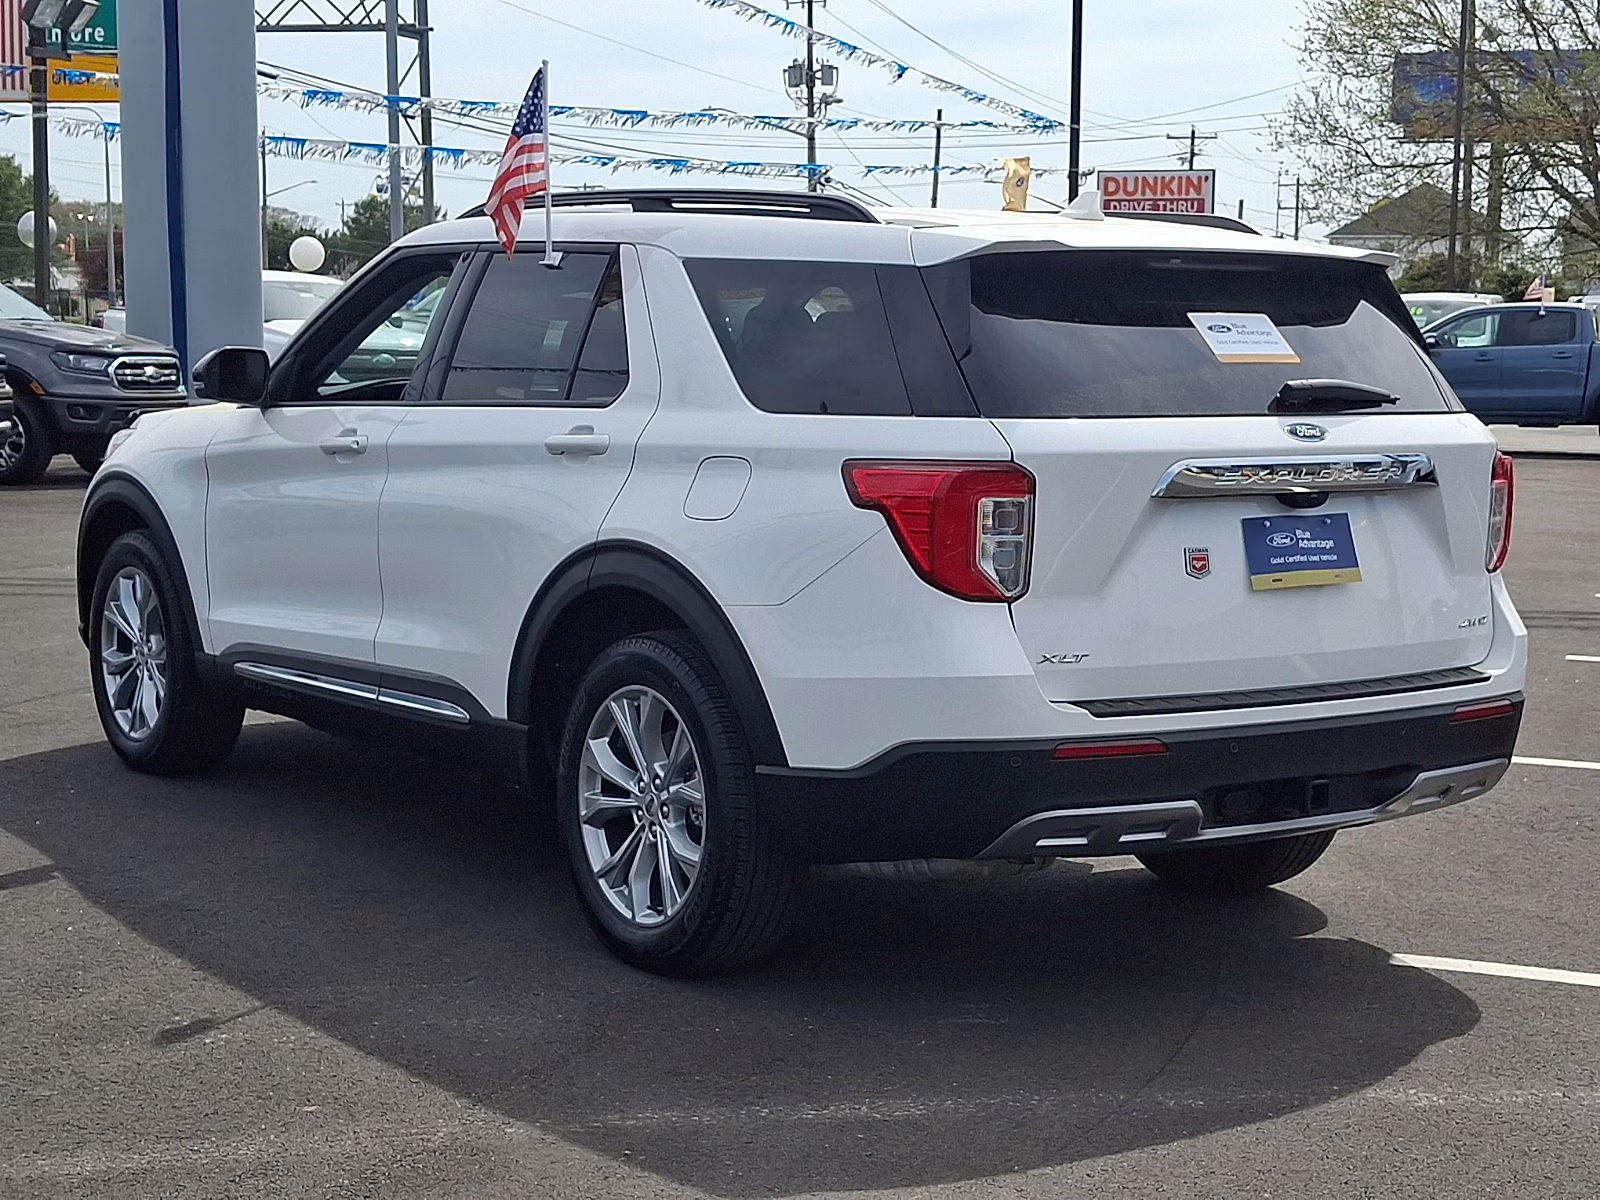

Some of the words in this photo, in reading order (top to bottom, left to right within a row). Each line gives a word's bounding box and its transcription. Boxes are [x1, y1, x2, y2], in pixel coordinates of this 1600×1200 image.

[1103, 175, 1209, 197] DUNKIN'
[1110, 201, 1152, 211] DRIVE
[1158, 201, 1198, 212] THRU
[1215, 466, 1402, 485] EXPLORER
[1295, 529, 1311, 538] Blue
[1298, 539, 1335, 549] Advantage
[1270, 556, 1284, 564] Gold
[1285, 554, 1307, 563] Certified
[1036, 653, 1090, 664] XLT
